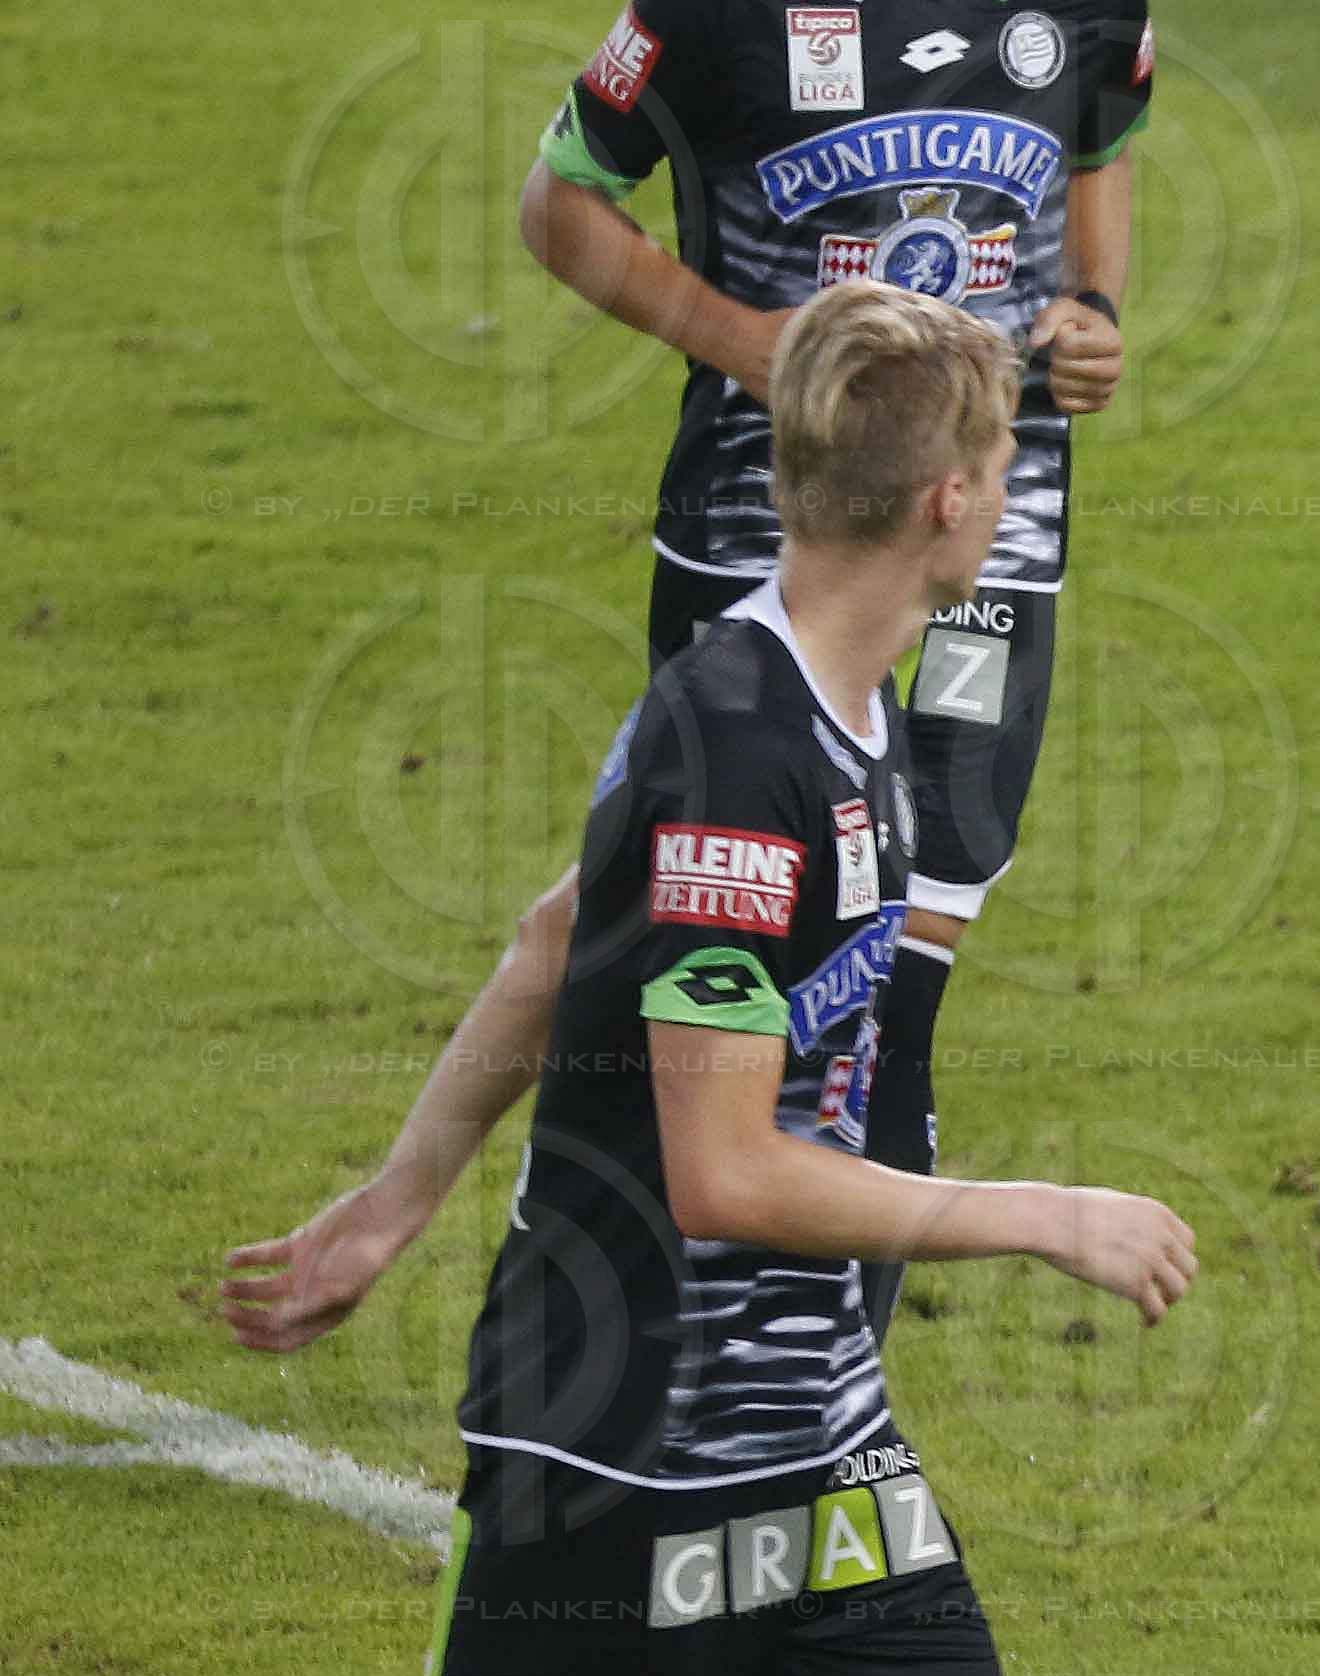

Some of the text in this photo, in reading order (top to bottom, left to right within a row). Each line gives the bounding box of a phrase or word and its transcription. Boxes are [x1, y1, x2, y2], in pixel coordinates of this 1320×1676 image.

[775, 122, 1051, 204] PUNTIGAME
[655, 831, 801, 888] KLEINE
[653, 877, 792, 927] ZEITUNG
[662, 1486, 947, 1617] GRAZ
